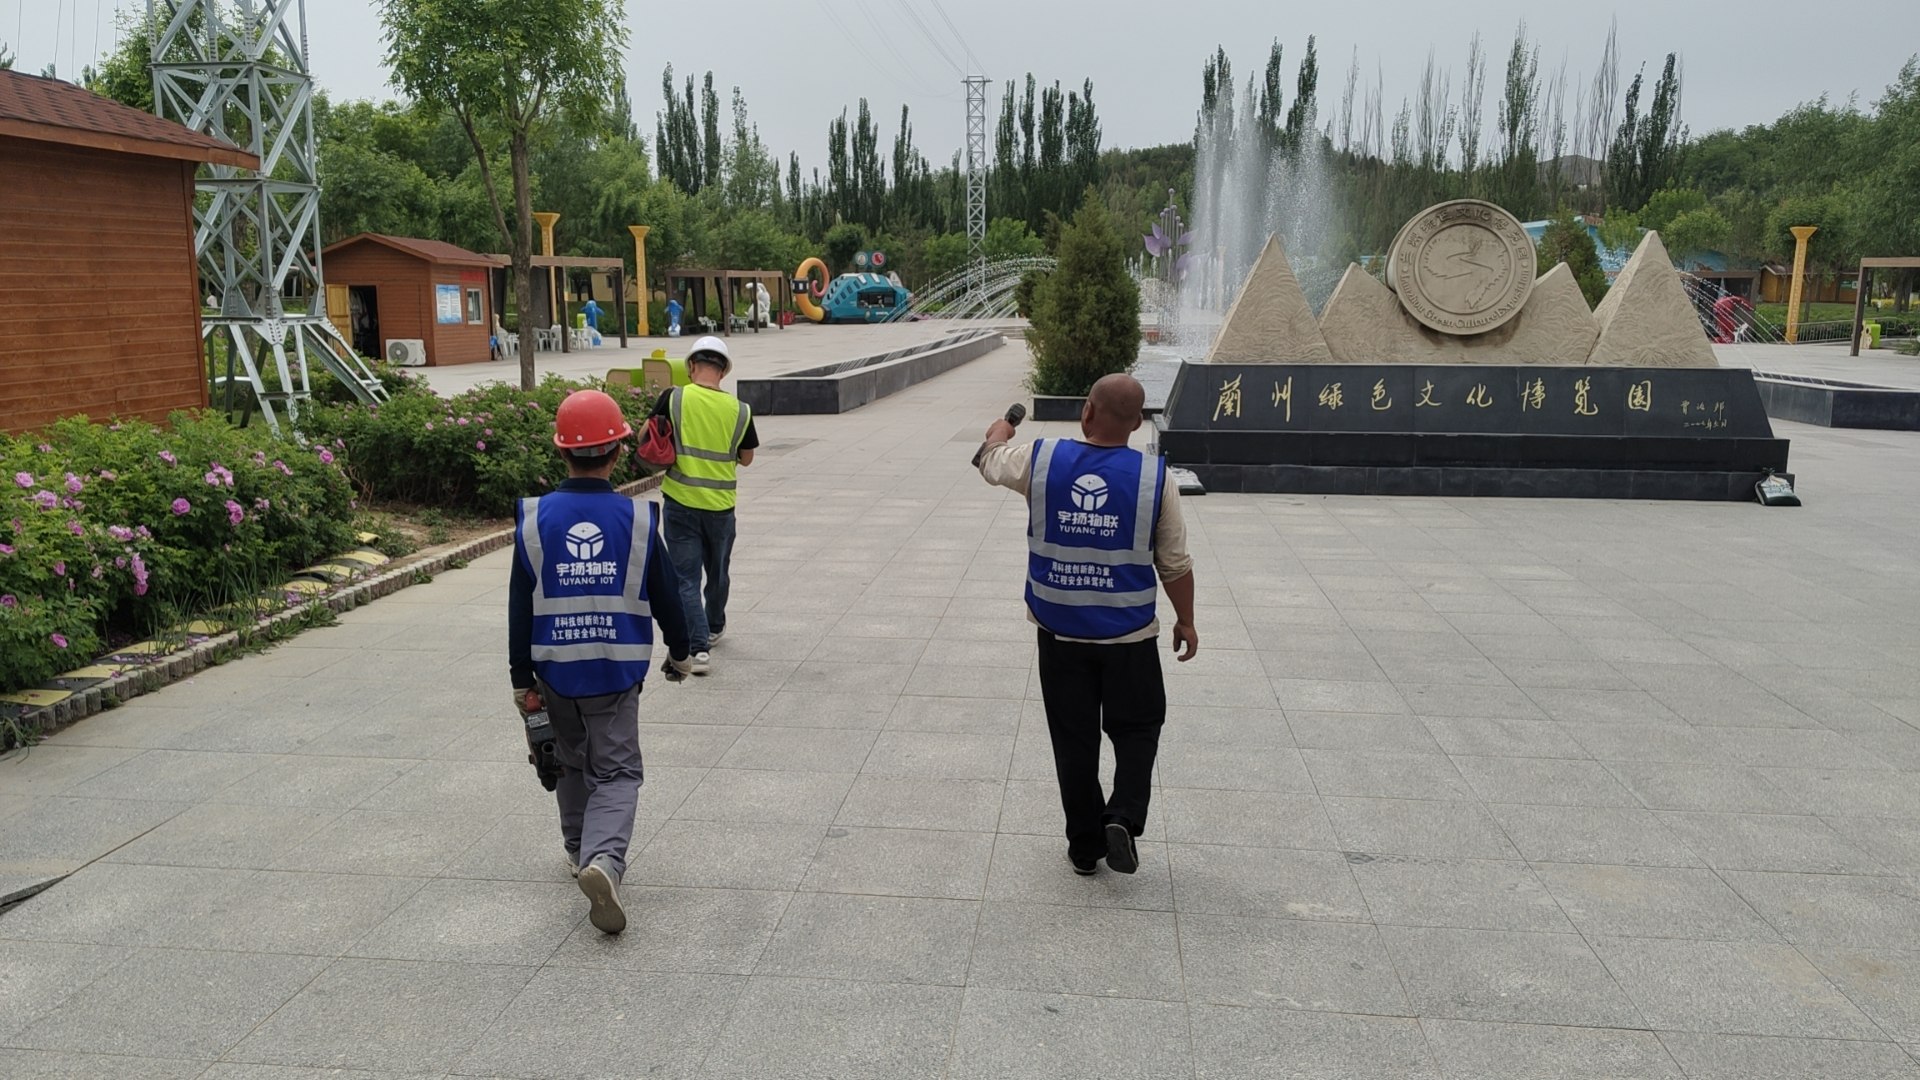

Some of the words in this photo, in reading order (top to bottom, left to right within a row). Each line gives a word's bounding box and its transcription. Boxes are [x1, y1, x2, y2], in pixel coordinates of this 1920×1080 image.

[1057, 510, 1119, 529] 宇扬物联
[1059, 525, 1096, 535] YUYANG
[1100, 529, 1116, 538] IOT
[556, 561, 617, 576] 宇扬物联
[1051, 561, 1110, 576] 用科技创新的力量
[559, 577, 595, 586] YUYANG
[600, 576, 615, 585] IOT
[1047, 571, 1114, 588] 为工程安全保驾护航
